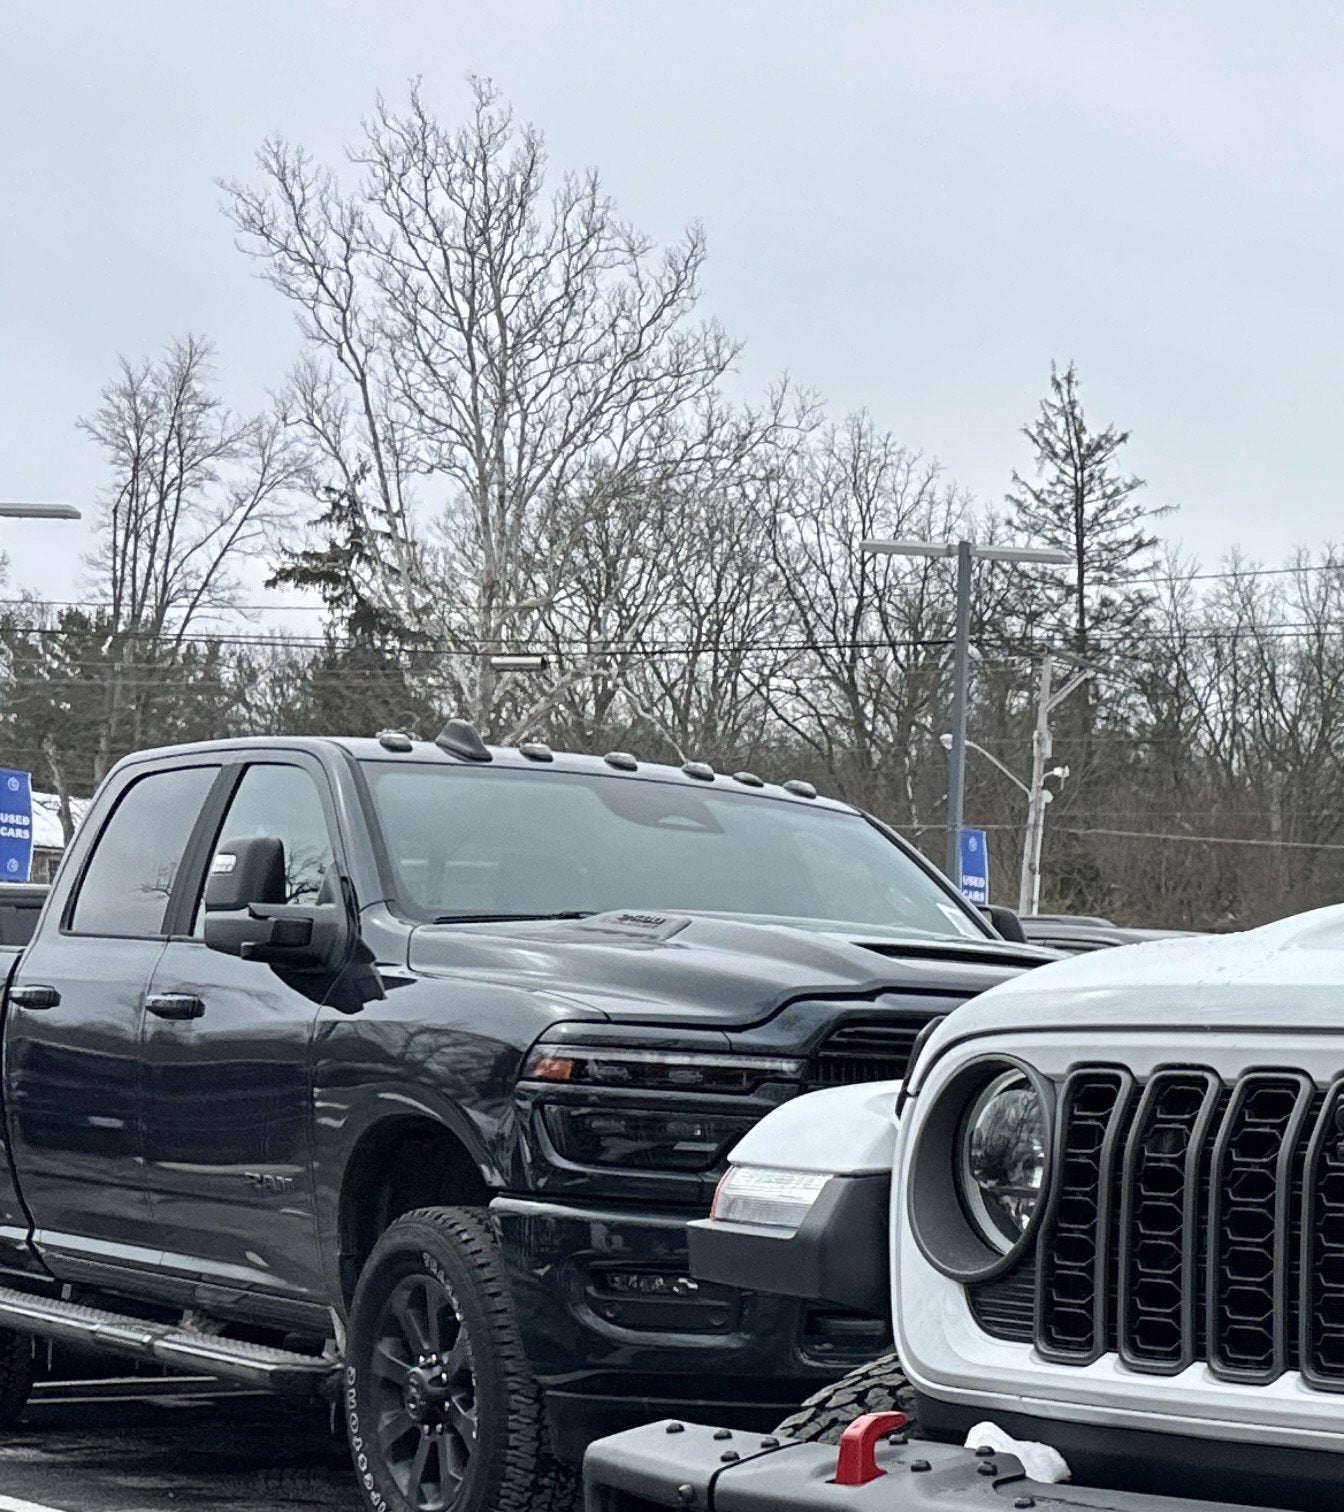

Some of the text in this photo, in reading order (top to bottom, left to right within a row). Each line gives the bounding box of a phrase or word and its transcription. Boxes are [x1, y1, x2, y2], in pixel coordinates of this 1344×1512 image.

[0, 813, 31, 826] USED
[0, 826, 31, 839] CARS
[962, 874, 985, 888] USED
